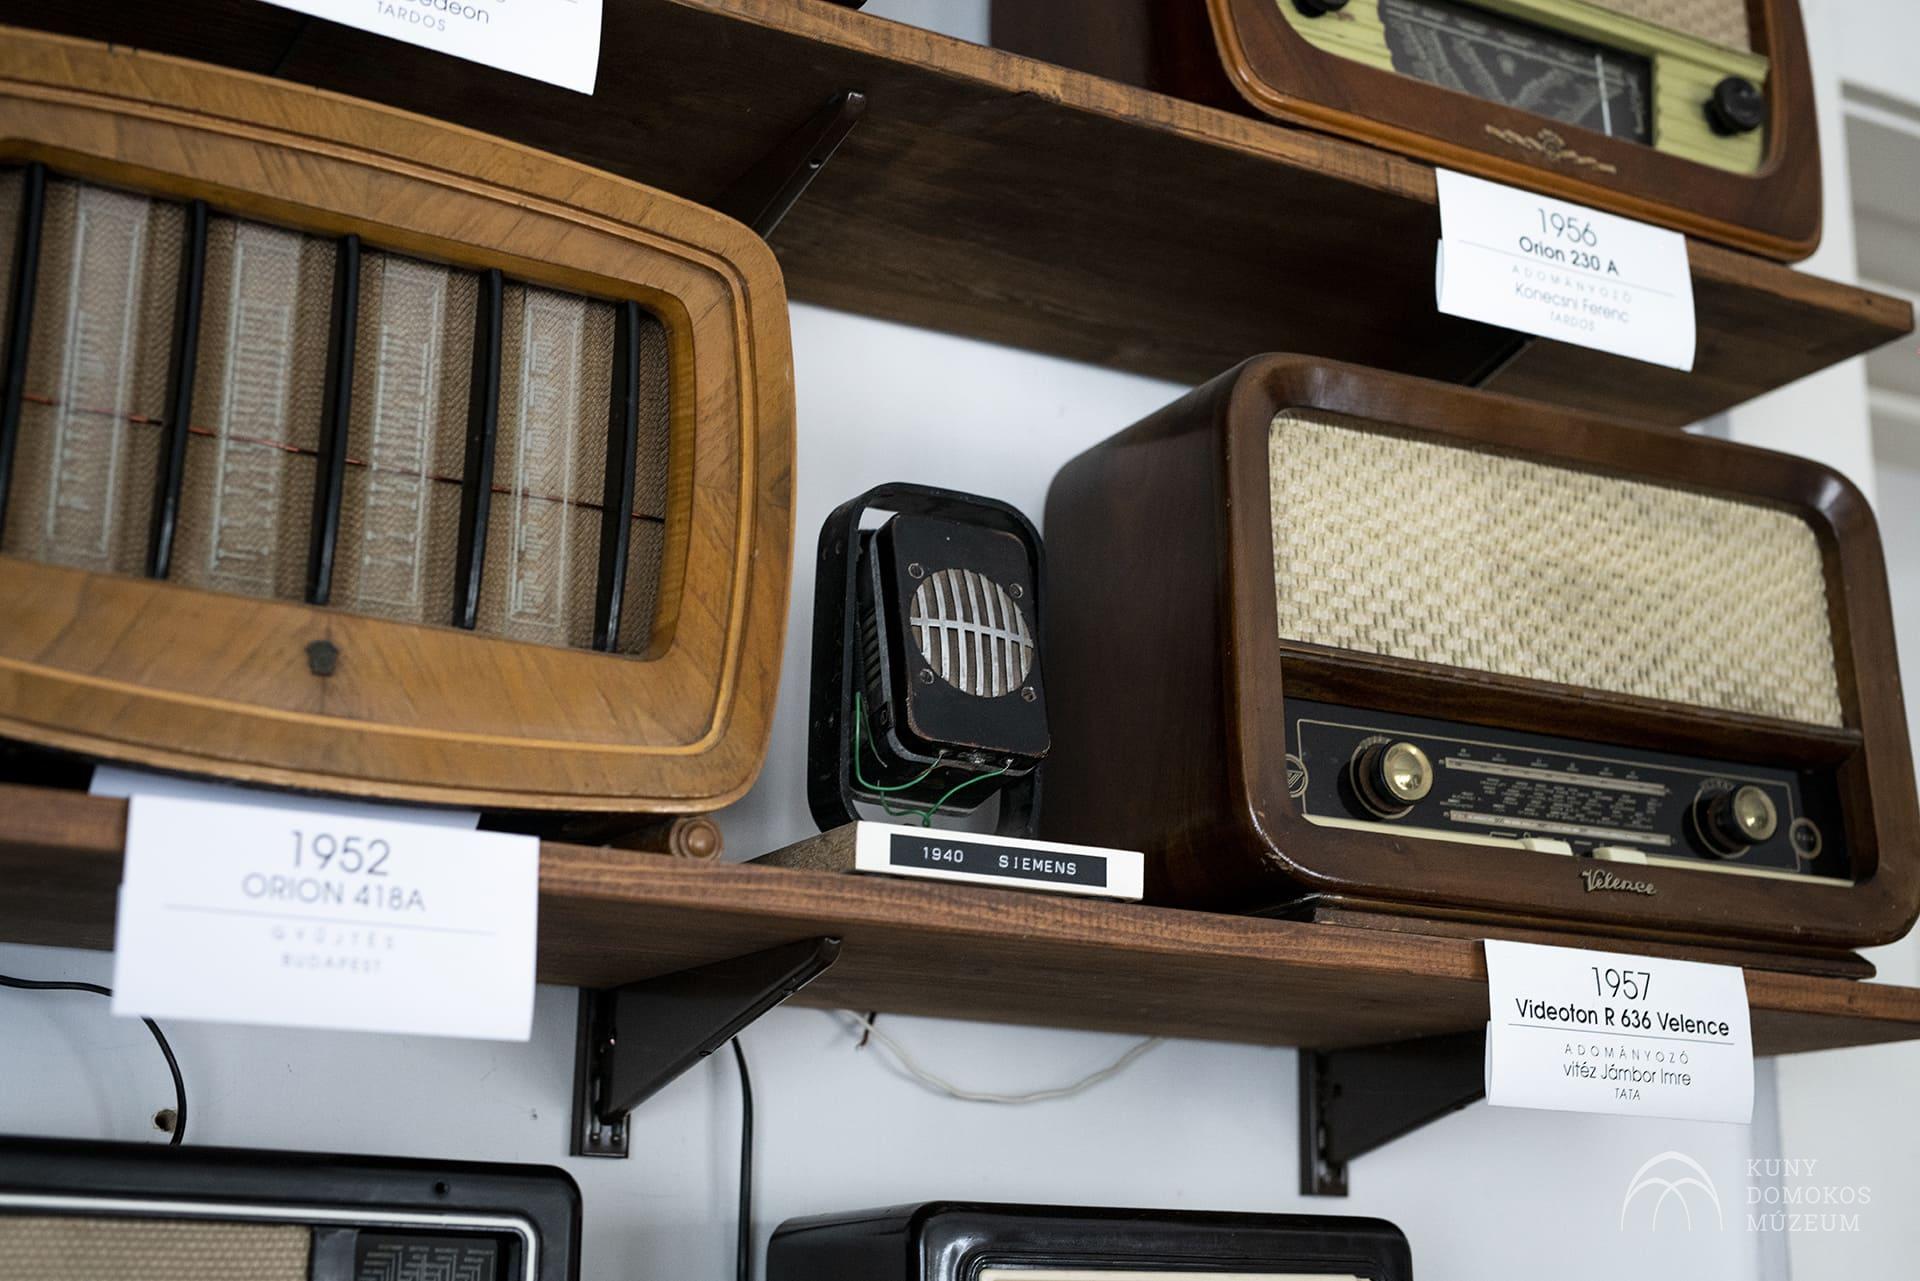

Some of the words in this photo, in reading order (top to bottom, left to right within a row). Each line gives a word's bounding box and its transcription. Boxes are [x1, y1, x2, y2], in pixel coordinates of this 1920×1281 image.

[377, 1, 446, 32] TARDOS
[1538, 208, 1598, 248] 1956
[1519, 236, 1565, 262] Orion
[1571, 250, 1601, 271] 230
[1607, 260, 1619, 276] A
[1582, 298, 1630, 324] Ferenc
[292, 829, 391, 877] 1952
[923, 846, 964, 863] 1940
[999, 855, 1077, 876] SIEMENS
[241, 872, 345, 905] ORION
[353, 884, 427, 912] 418A
[1582, 868, 1657, 895] Velence
[1592, 967, 1651, 1001] 1957
[1515, 998, 1599, 1026] Videoton
[1605, 1007, 1615, 1027] R
[1621, 1008, 1651, 1030] 636
[1656, 1011, 1730, 1037] Velence
[1564, 1043, 1689, 1065] ADOMÁNYOZÓ
[1563, 1061, 1597, 1080] vitéz
[1600, 1063, 1657, 1086] Jámbor
[1660, 1071, 1691, 1087] Imre
[1615, 1087, 1641, 1101] TATA
